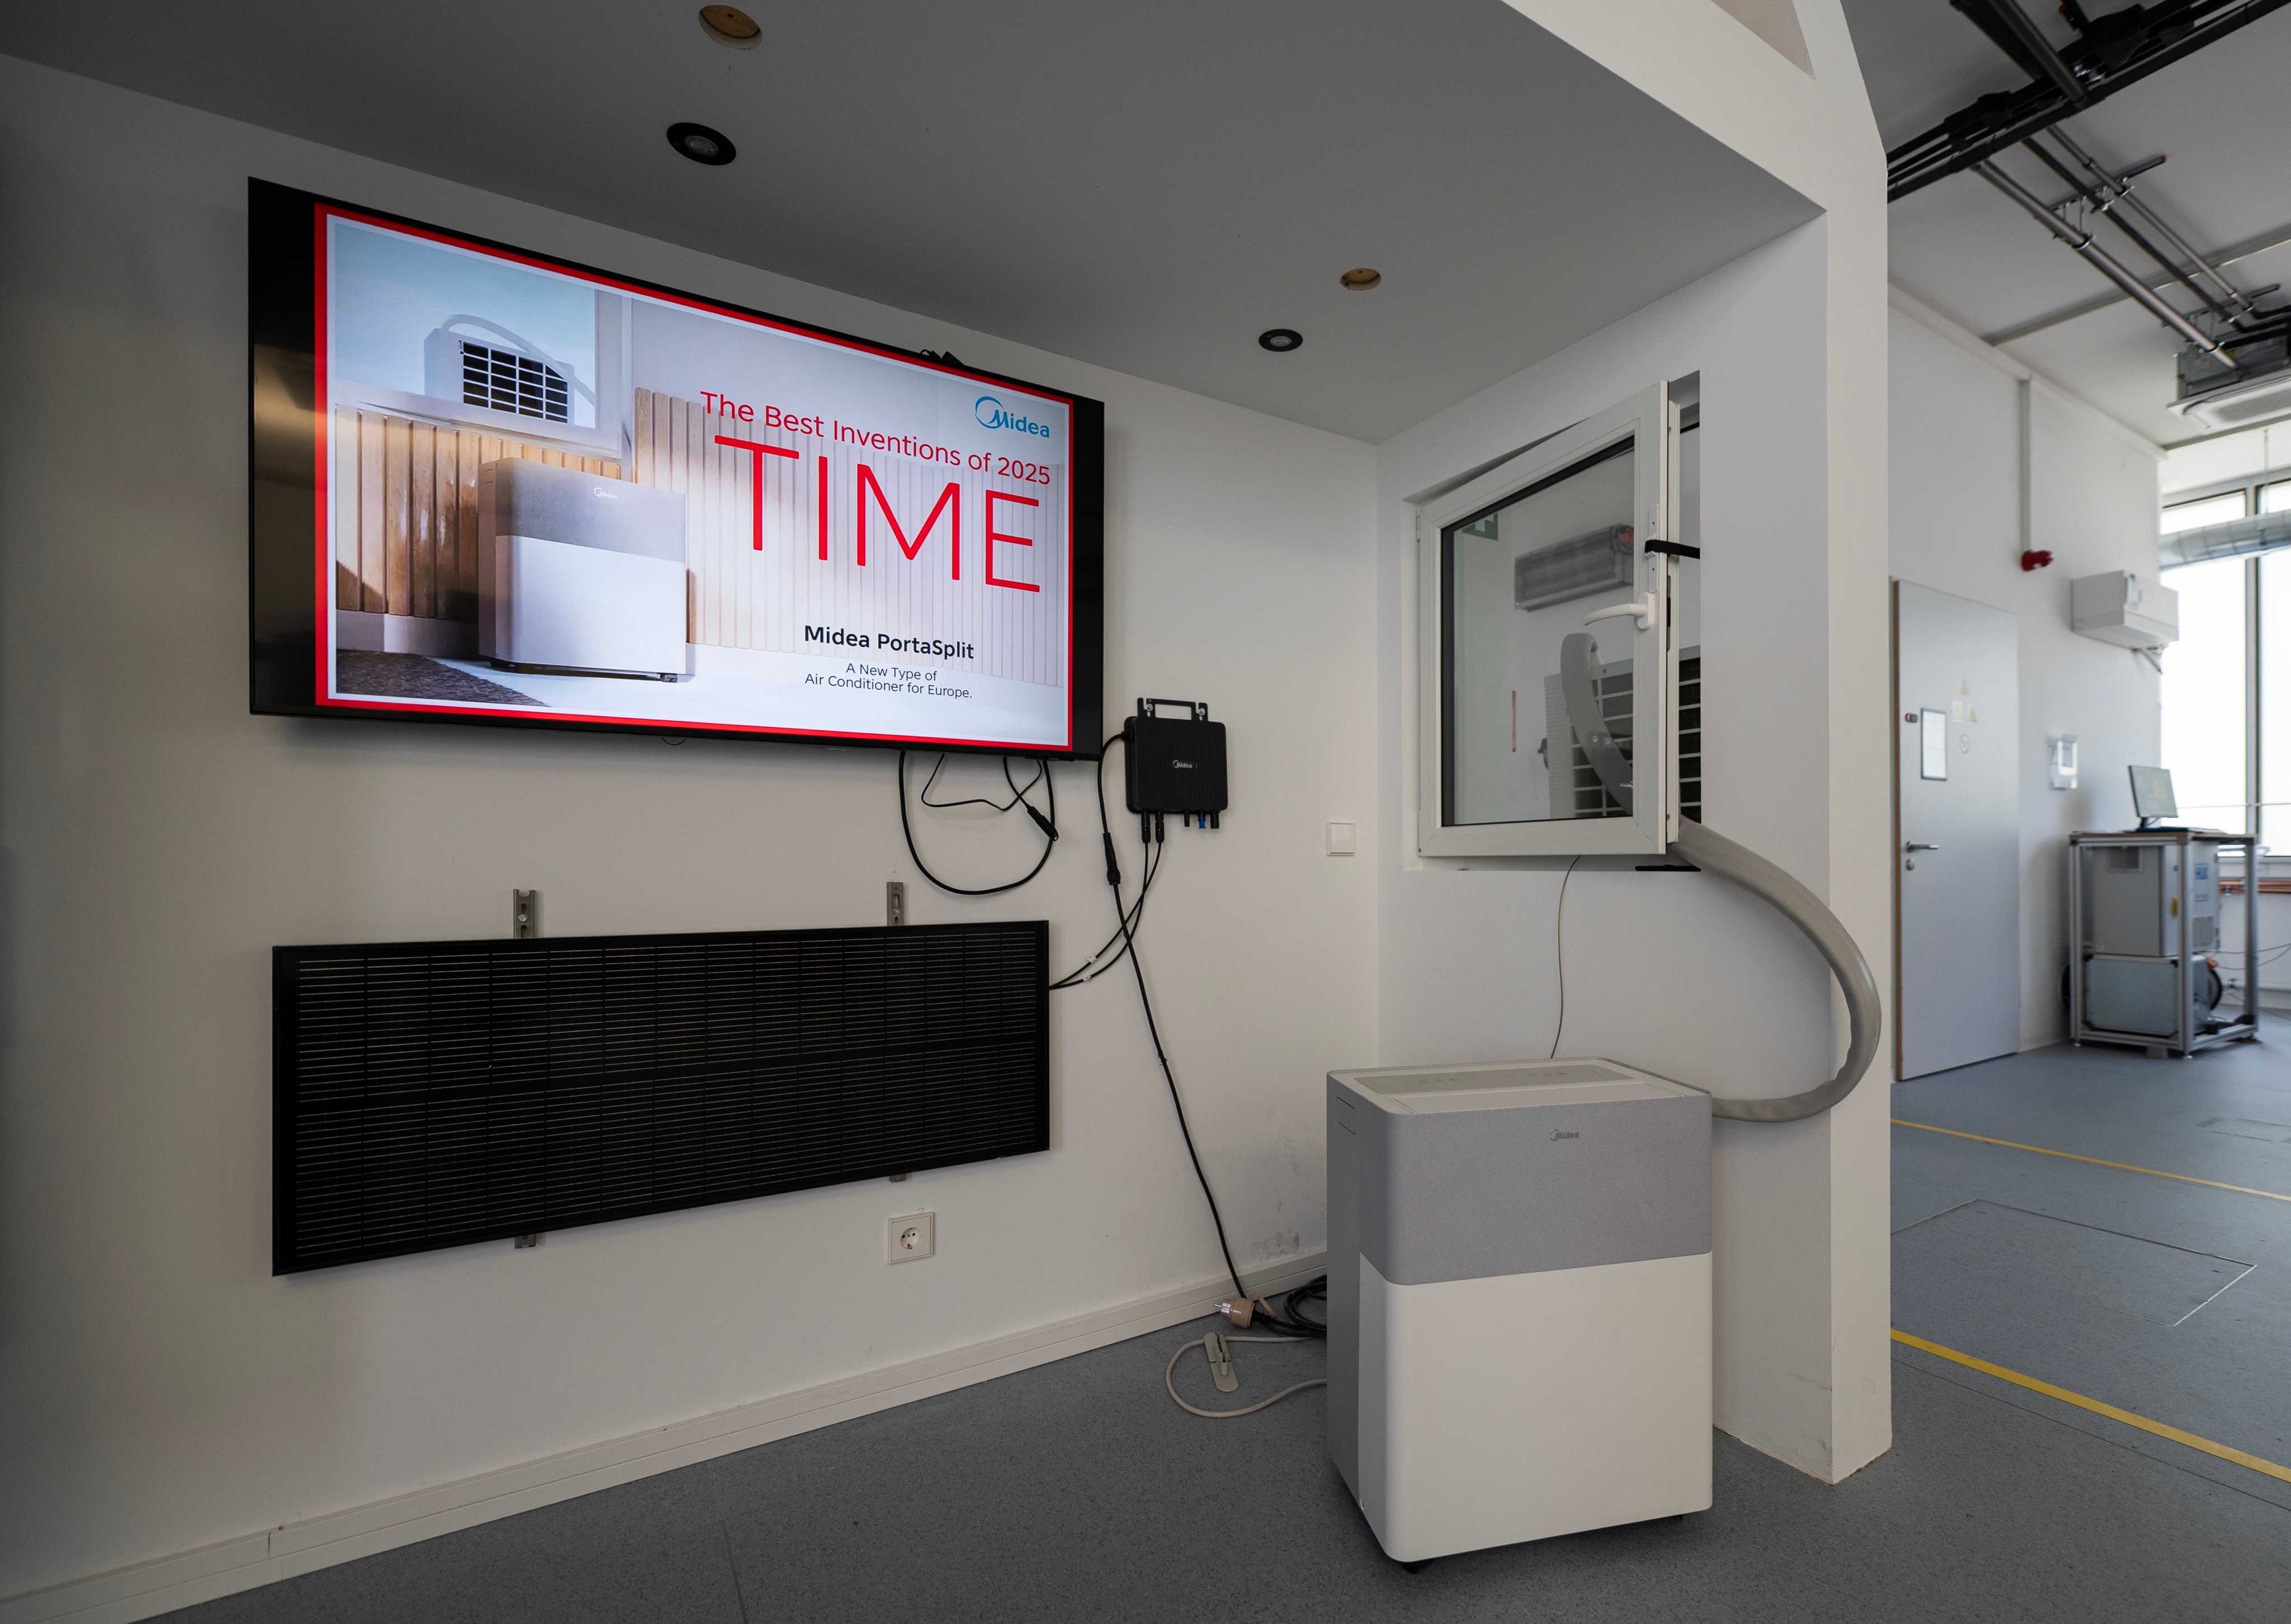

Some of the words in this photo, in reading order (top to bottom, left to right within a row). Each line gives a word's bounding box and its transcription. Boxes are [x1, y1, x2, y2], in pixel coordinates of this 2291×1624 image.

[974, 396, 1050, 438] Midea
[700, 391, 754, 422] The
[765, 405, 824, 438] Best
[834, 421, 960, 465] Inventions
[968, 452, 991, 471] of
[998, 457, 1050, 485] 2025
[715, 435, 1040, 593] TIME
[805, 625, 869, 648] Midea
[878, 633, 974, 660] PortaSplit
[805, 674, 824, 685] Air
[828, 676, 903, 692] Conditioner
[907, 683, 924, 693] for
[928, 684, 972, 699] Europe.
[846, 663, 855, 673] A
[860, 664, 888, 676] New
[892, 667, 921, 681] Type
[925, 671, 937, 681] of
[1173, 760, 1192, 768] Midea
[1549, 1129, 1579, 1141] Midea
